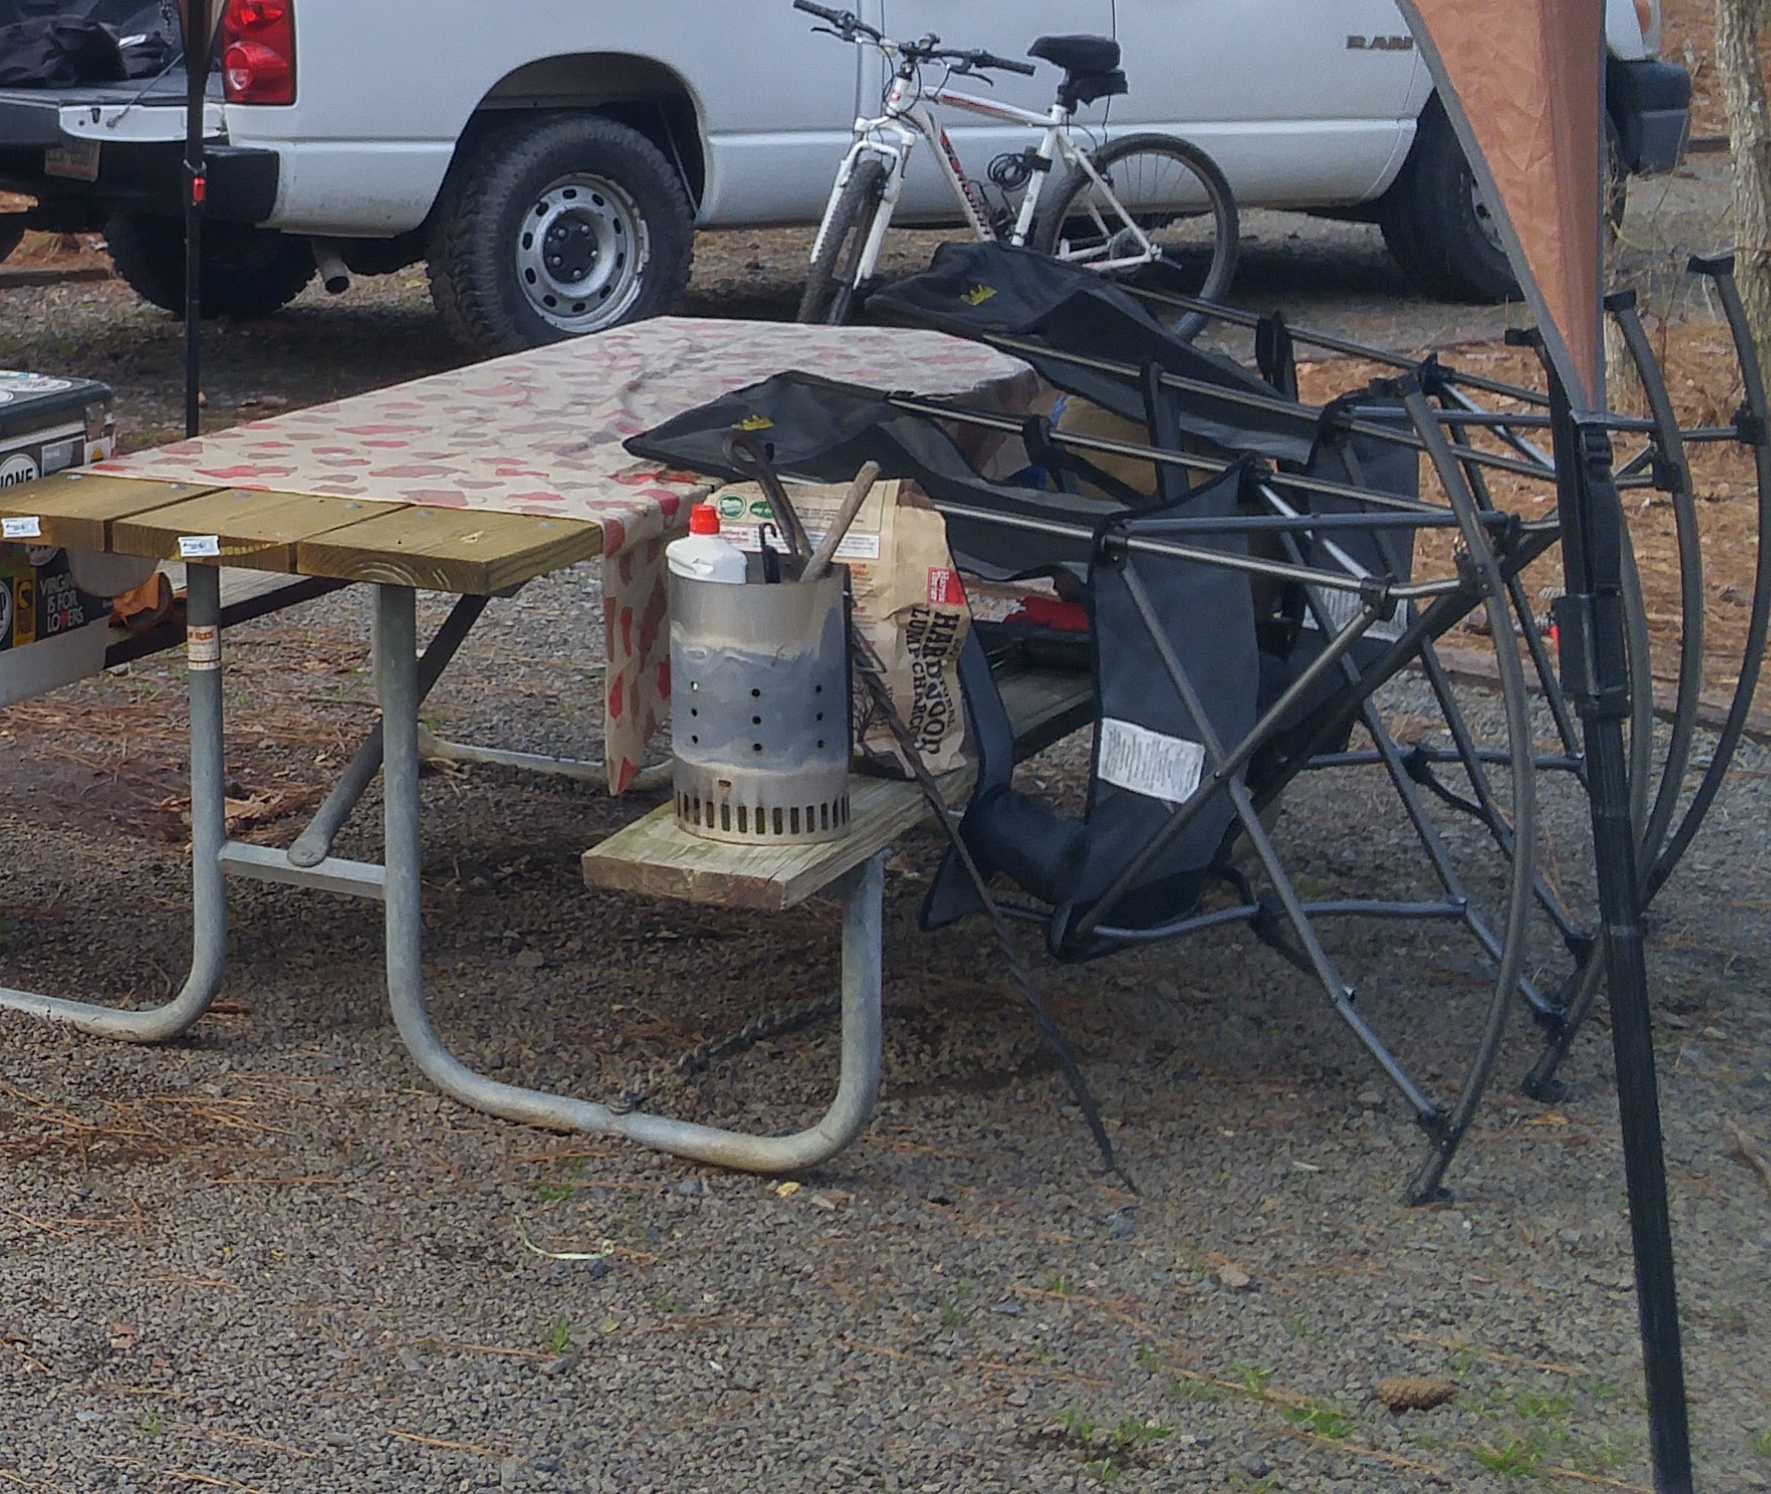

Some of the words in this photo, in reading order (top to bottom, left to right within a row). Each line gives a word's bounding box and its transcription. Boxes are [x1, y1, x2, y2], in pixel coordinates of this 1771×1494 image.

[47, 596, 56, 614] IS
[57, 590, 78, 610] FOR
[906, 608, 931, 661] LUMP
[908, 661, 928, 735] CHARCO
